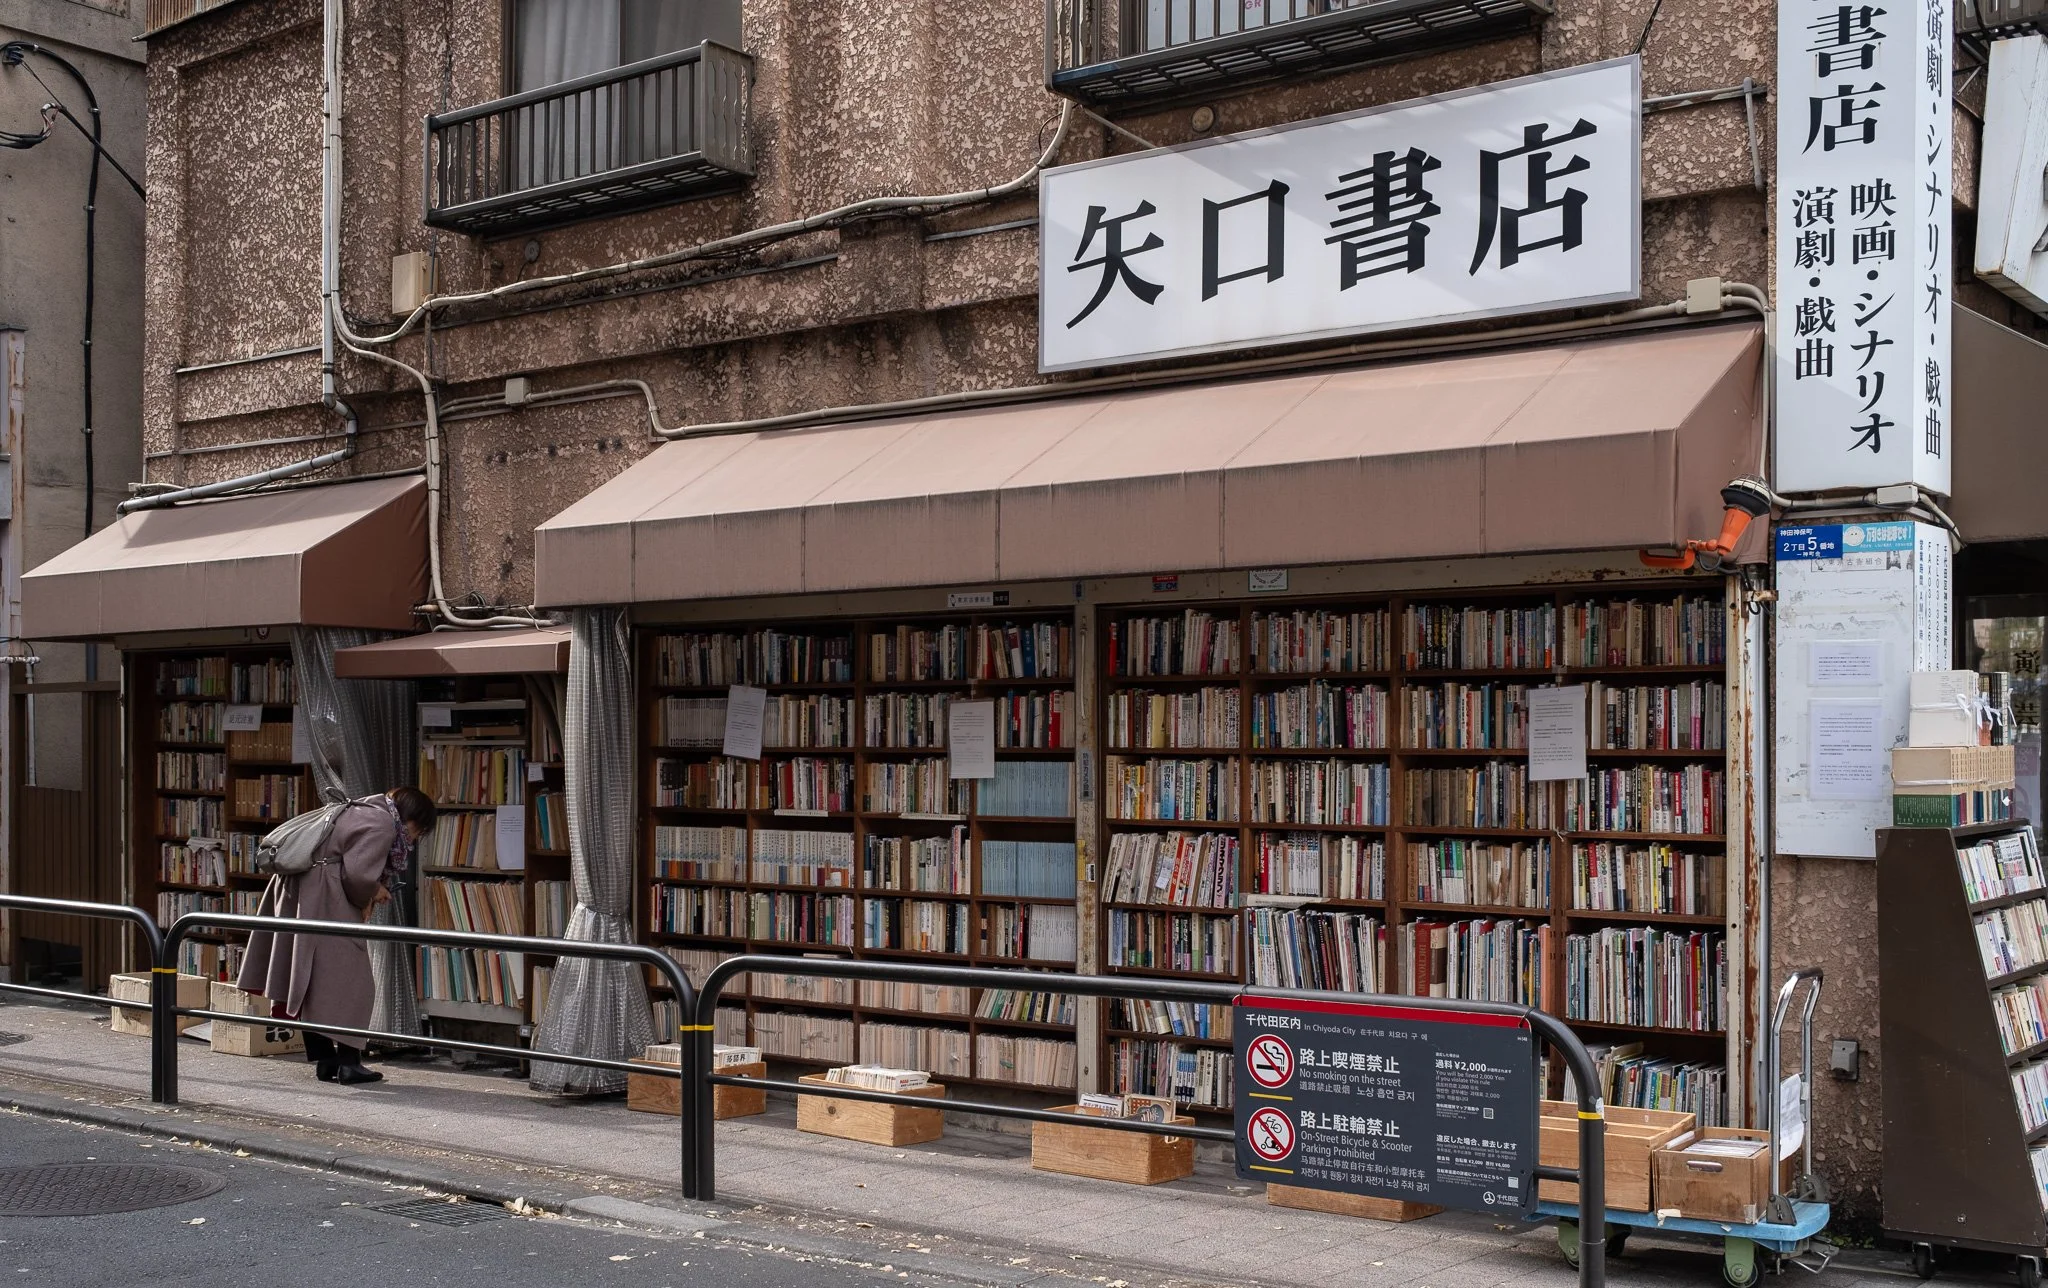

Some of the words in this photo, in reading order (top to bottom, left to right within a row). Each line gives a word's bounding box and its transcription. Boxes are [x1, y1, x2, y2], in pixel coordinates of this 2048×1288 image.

[1801, 0, 1888, 155] 書店
[1066, 117, 1597, 330] 矢口書店
[1792, 186, 1838, 380] 演劇・戯曲
[1847, 178, 1896, 454] 映画・シナリオ
[1780, 528, 1813, 536] 神田神保町
[1245, 1013, 1301, 1030] 千代田区内
[1312, 1024, 1341, 1034] Chiyoda
[1342, 1026, 1356, 1036] City
[1388, 1031, 1408, 1040] 치요다
[1411, 1032, 1418, 1040] 구
[1300, 1048, 1401, 1074] 路上喫煙禁止
[1435, 1059, 1453, 1069] 過料
[1454, 1061, 1487, 1072] ¥2,000
[1300, 1068, 1311, 1078] No
[1312, 1070, 1347, 1084] smoking
[1349, 1074, 1359, 1083] on
[1361, 1073, 1375, 1085] the
[1376, 1075, 1401, 1087] street
[1356, 1086, 1374, 1097] 노상
[1377, 1087, 1394, 1100] 흡연
[1397, 1090, 1415, 1101] 금지
[1300, 1110, 1400, 1138] 路上駐輪禁止
[1300, 1130, 1339, 1144] On-Street
[1341, 1135, 1370, 1148] Bicycle
[1371, 1138, 1379, 1149] &
[1381, 1139, 1413, 1153] Scooter
[1436, 1134, 1517, 1150] 違反した場合、撤去します
[1301, 1142, 1331, 1158] Parking
[1333, 1147, 1375, 1161] Prohibited
[1300, 1167, 1320, 1178] 자전거
[1321, 1169, 1328, 1179] 및
[1350, 1173, 1363, 1184] 장치
[1364, 1175, 1384, 1186] 자전거
[1386, 1178, 1399, 1189] 노상
[1400, 1180, 1415, 1191] 주차
[1416, 1182, 1430, 1192] 금지
[1497, 1194, 1519, 1202] 千代田区
